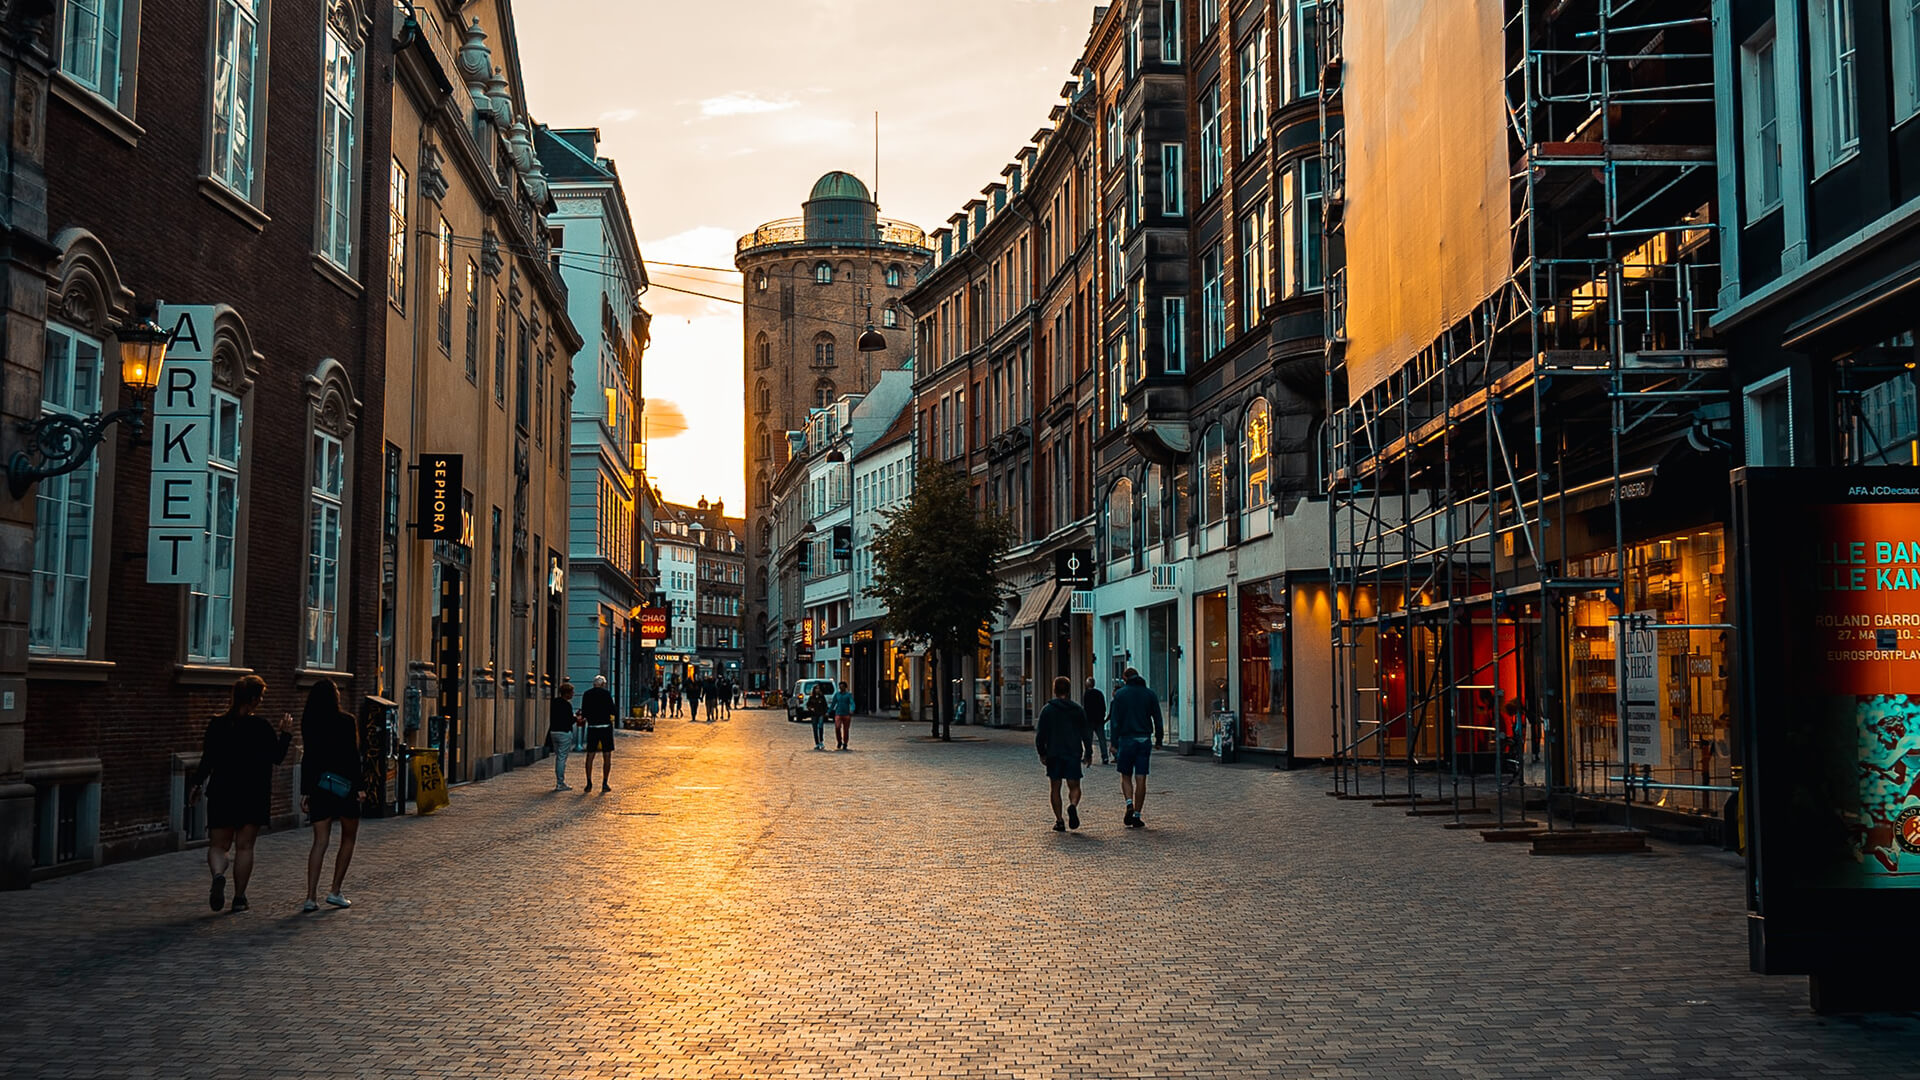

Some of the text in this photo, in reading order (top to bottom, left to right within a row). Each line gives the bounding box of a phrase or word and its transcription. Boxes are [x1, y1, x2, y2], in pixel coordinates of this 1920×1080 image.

[159, 312, 202, 576] ARKET
[433, 460, 447, 533] SEPHORA
[1848, 486, 1920, 496] AFA JCDecaux
[641, 614, 666, 622] CHAO
[641, 625, 666, 633] CHAO
[1636, 631, 1654, 654] END
[1630, 655, 1653, 679] HERE
